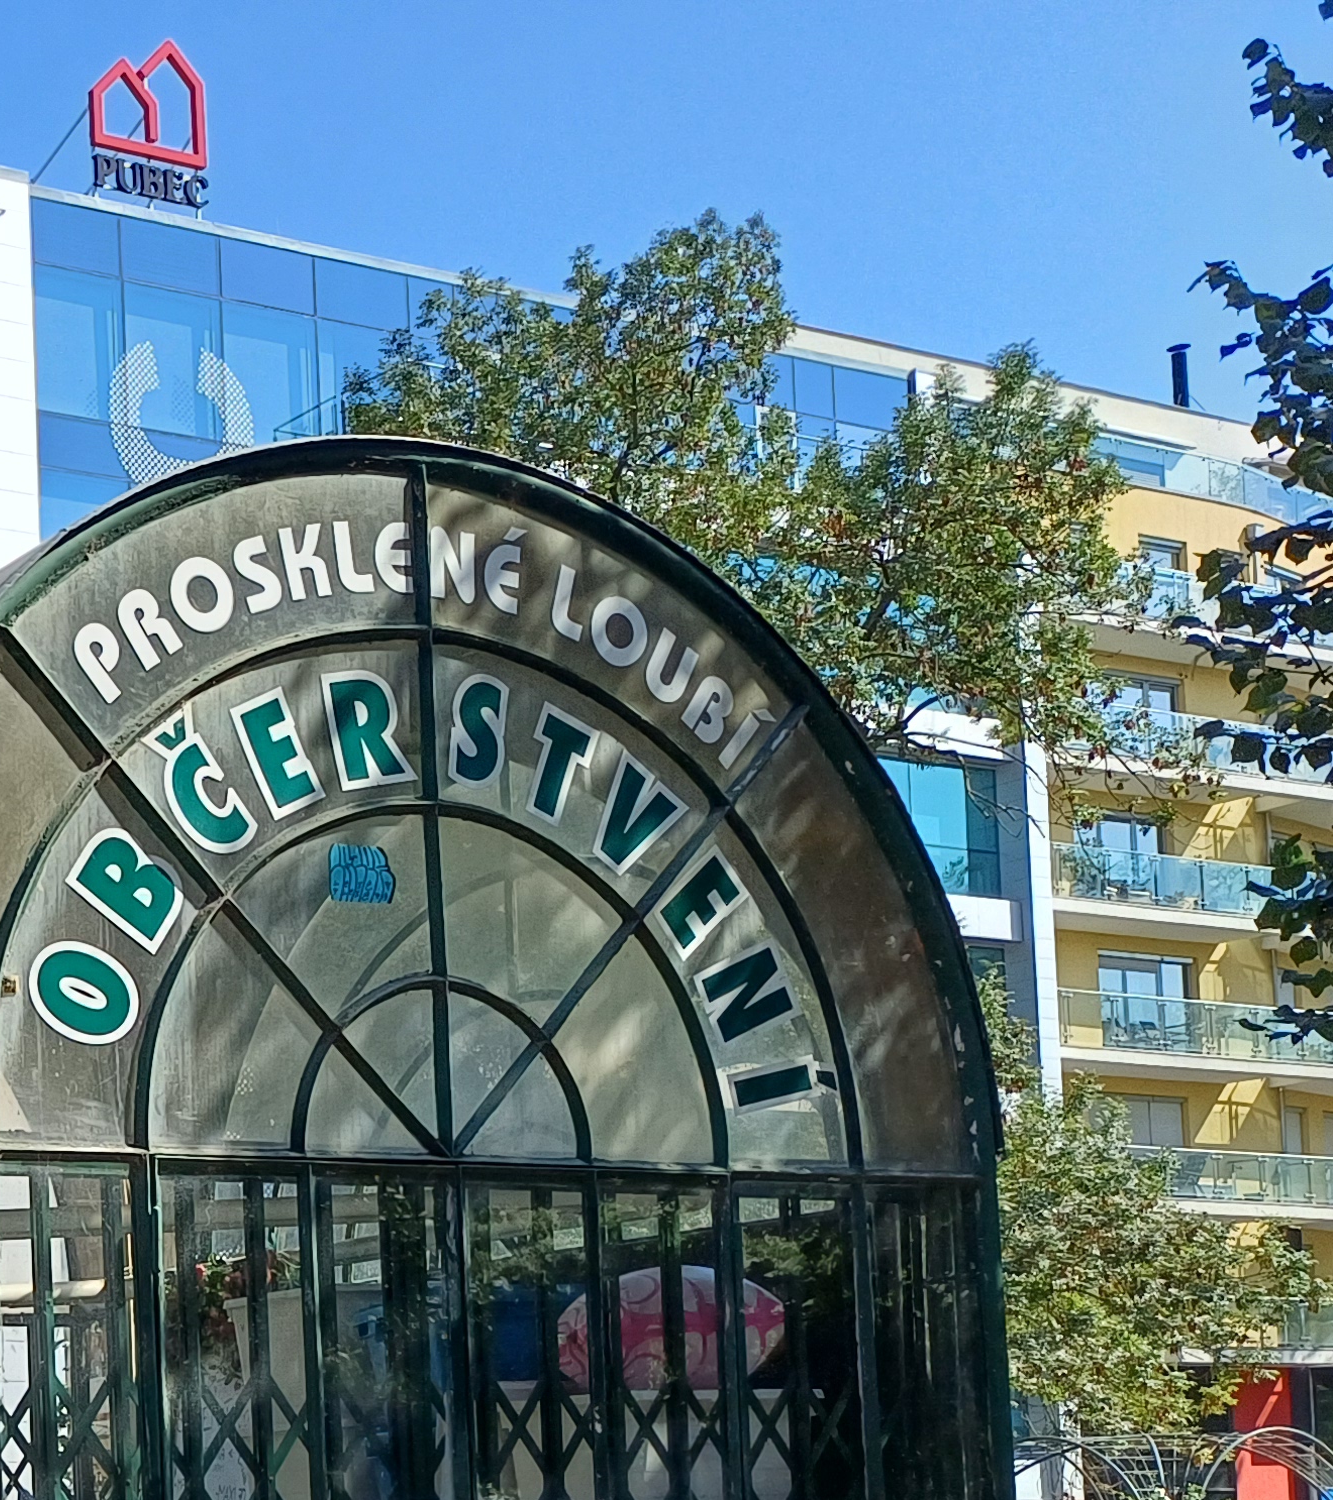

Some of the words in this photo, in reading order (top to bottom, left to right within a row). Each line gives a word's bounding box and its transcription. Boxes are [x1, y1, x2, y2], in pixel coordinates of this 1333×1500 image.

[92, 153, 209, 209] PUBEC
[73, 520, 524, 704] PROSKLENÉ
[550, 563, 775, 770] LOUBÍ
[27, 668, 841, 1114] OBČERSTVENÍ
